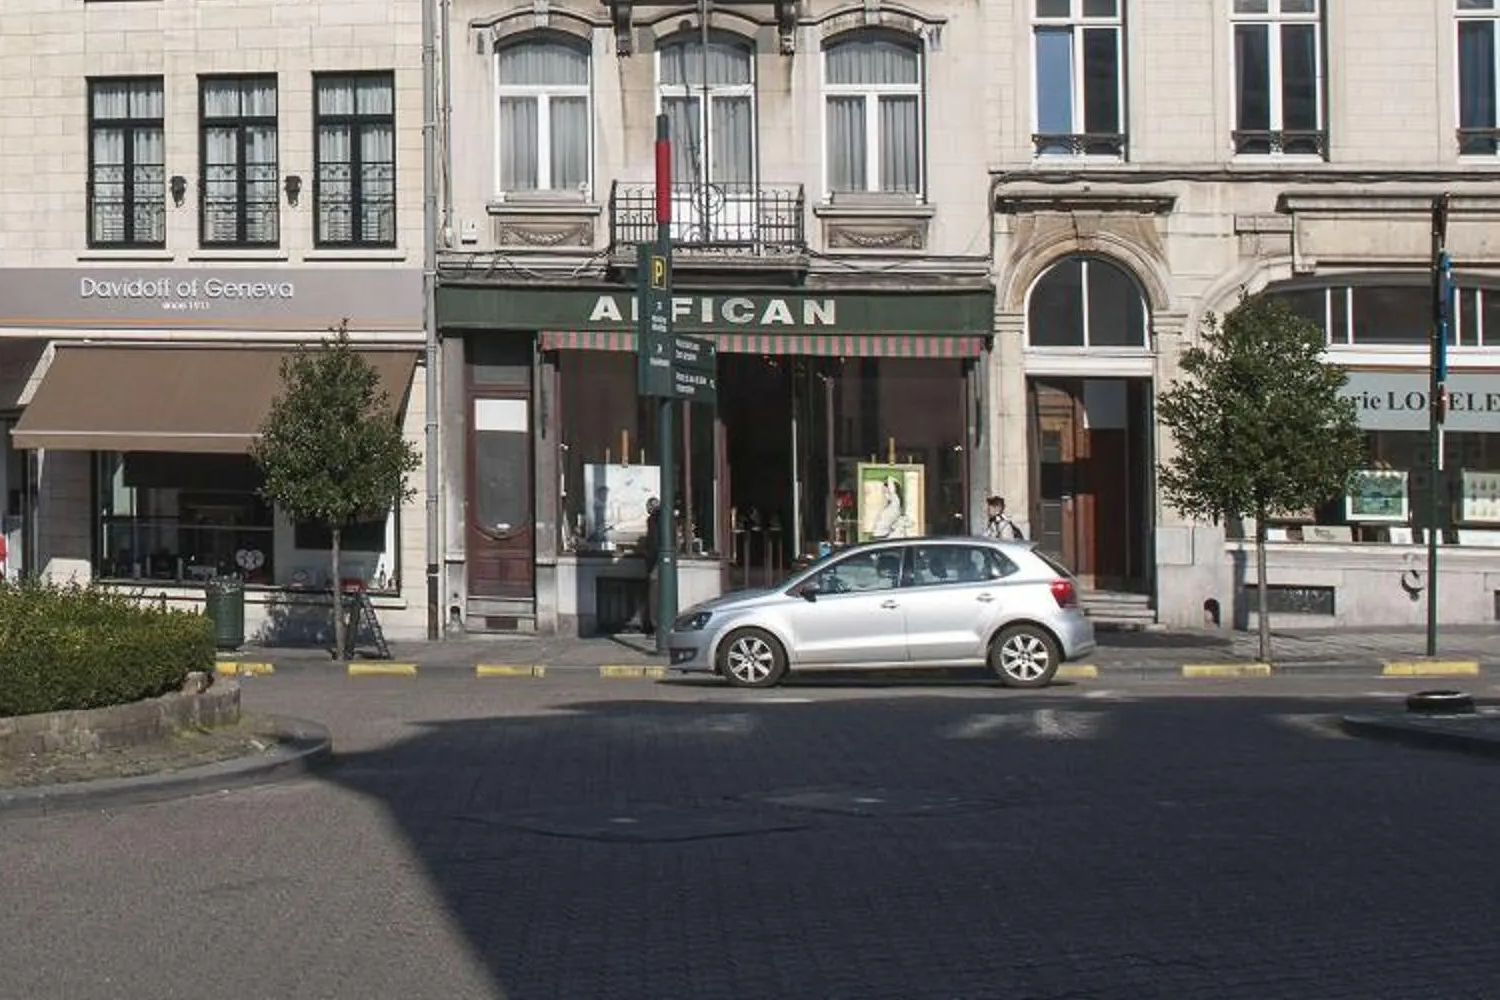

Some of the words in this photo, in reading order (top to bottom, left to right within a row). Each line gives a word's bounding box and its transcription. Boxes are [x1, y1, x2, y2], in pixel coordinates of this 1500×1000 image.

[80, 277, 171, 298] Davidoff
[176, 277, 200, 298] of
[203, 277, 294, 298] Geneva
